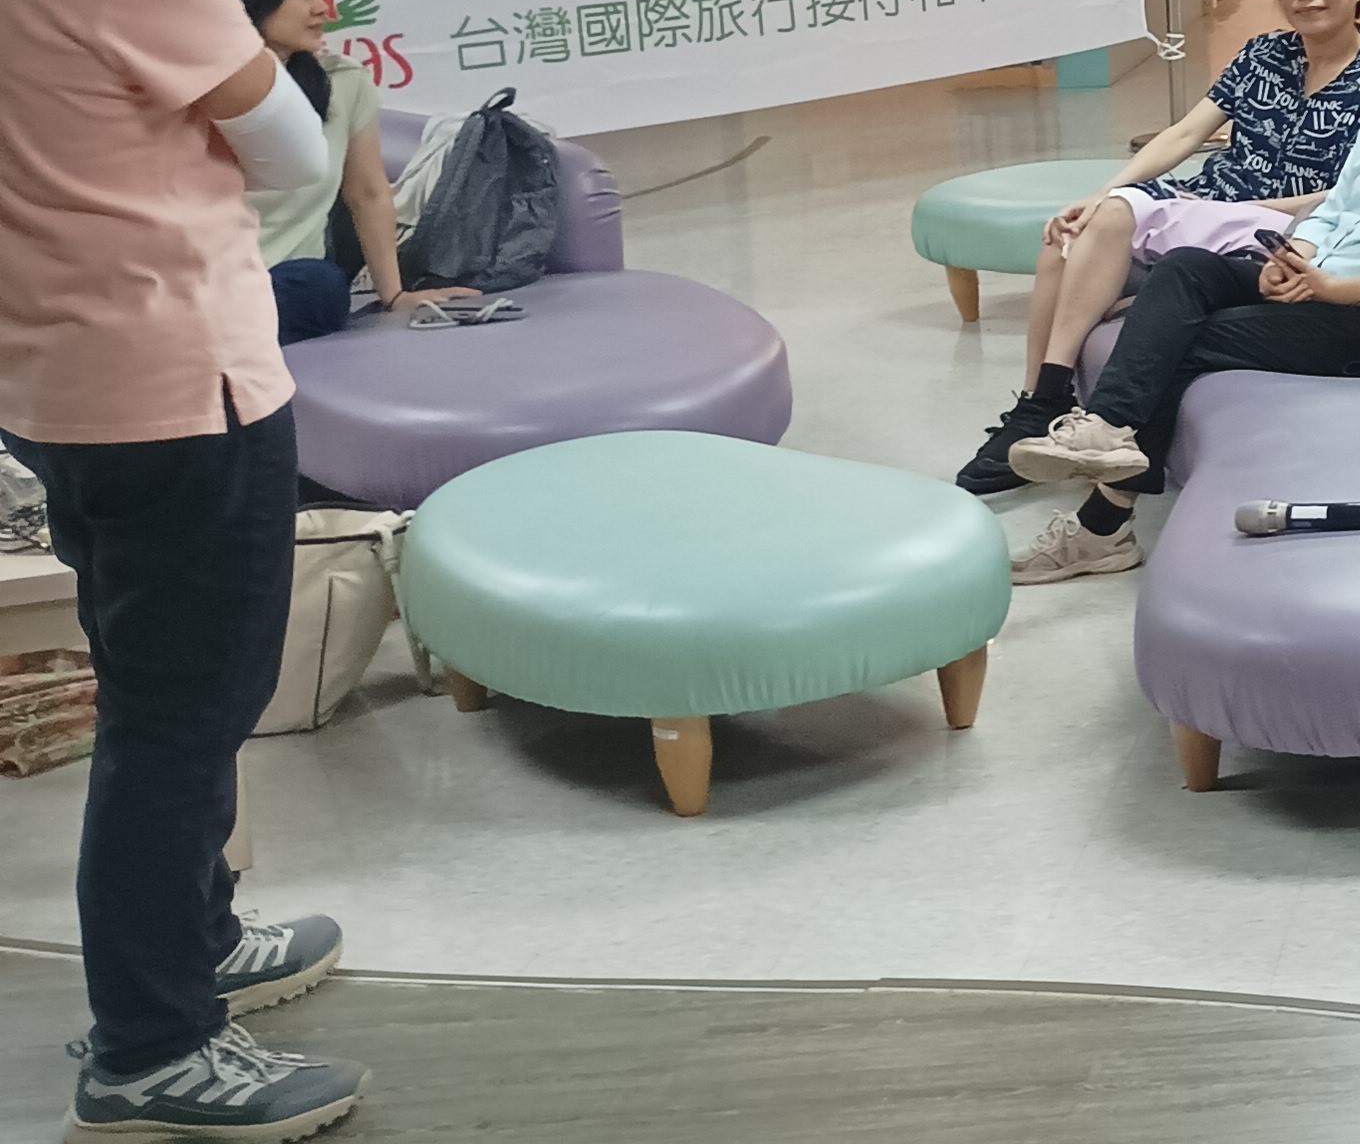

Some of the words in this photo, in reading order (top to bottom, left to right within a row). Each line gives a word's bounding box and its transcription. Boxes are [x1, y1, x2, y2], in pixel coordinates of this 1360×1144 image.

[1249, 60, 1285, 88] THANK
[1274, 86, 1299, 110] YOU
[1242, 147, 1273, 173] YOU
